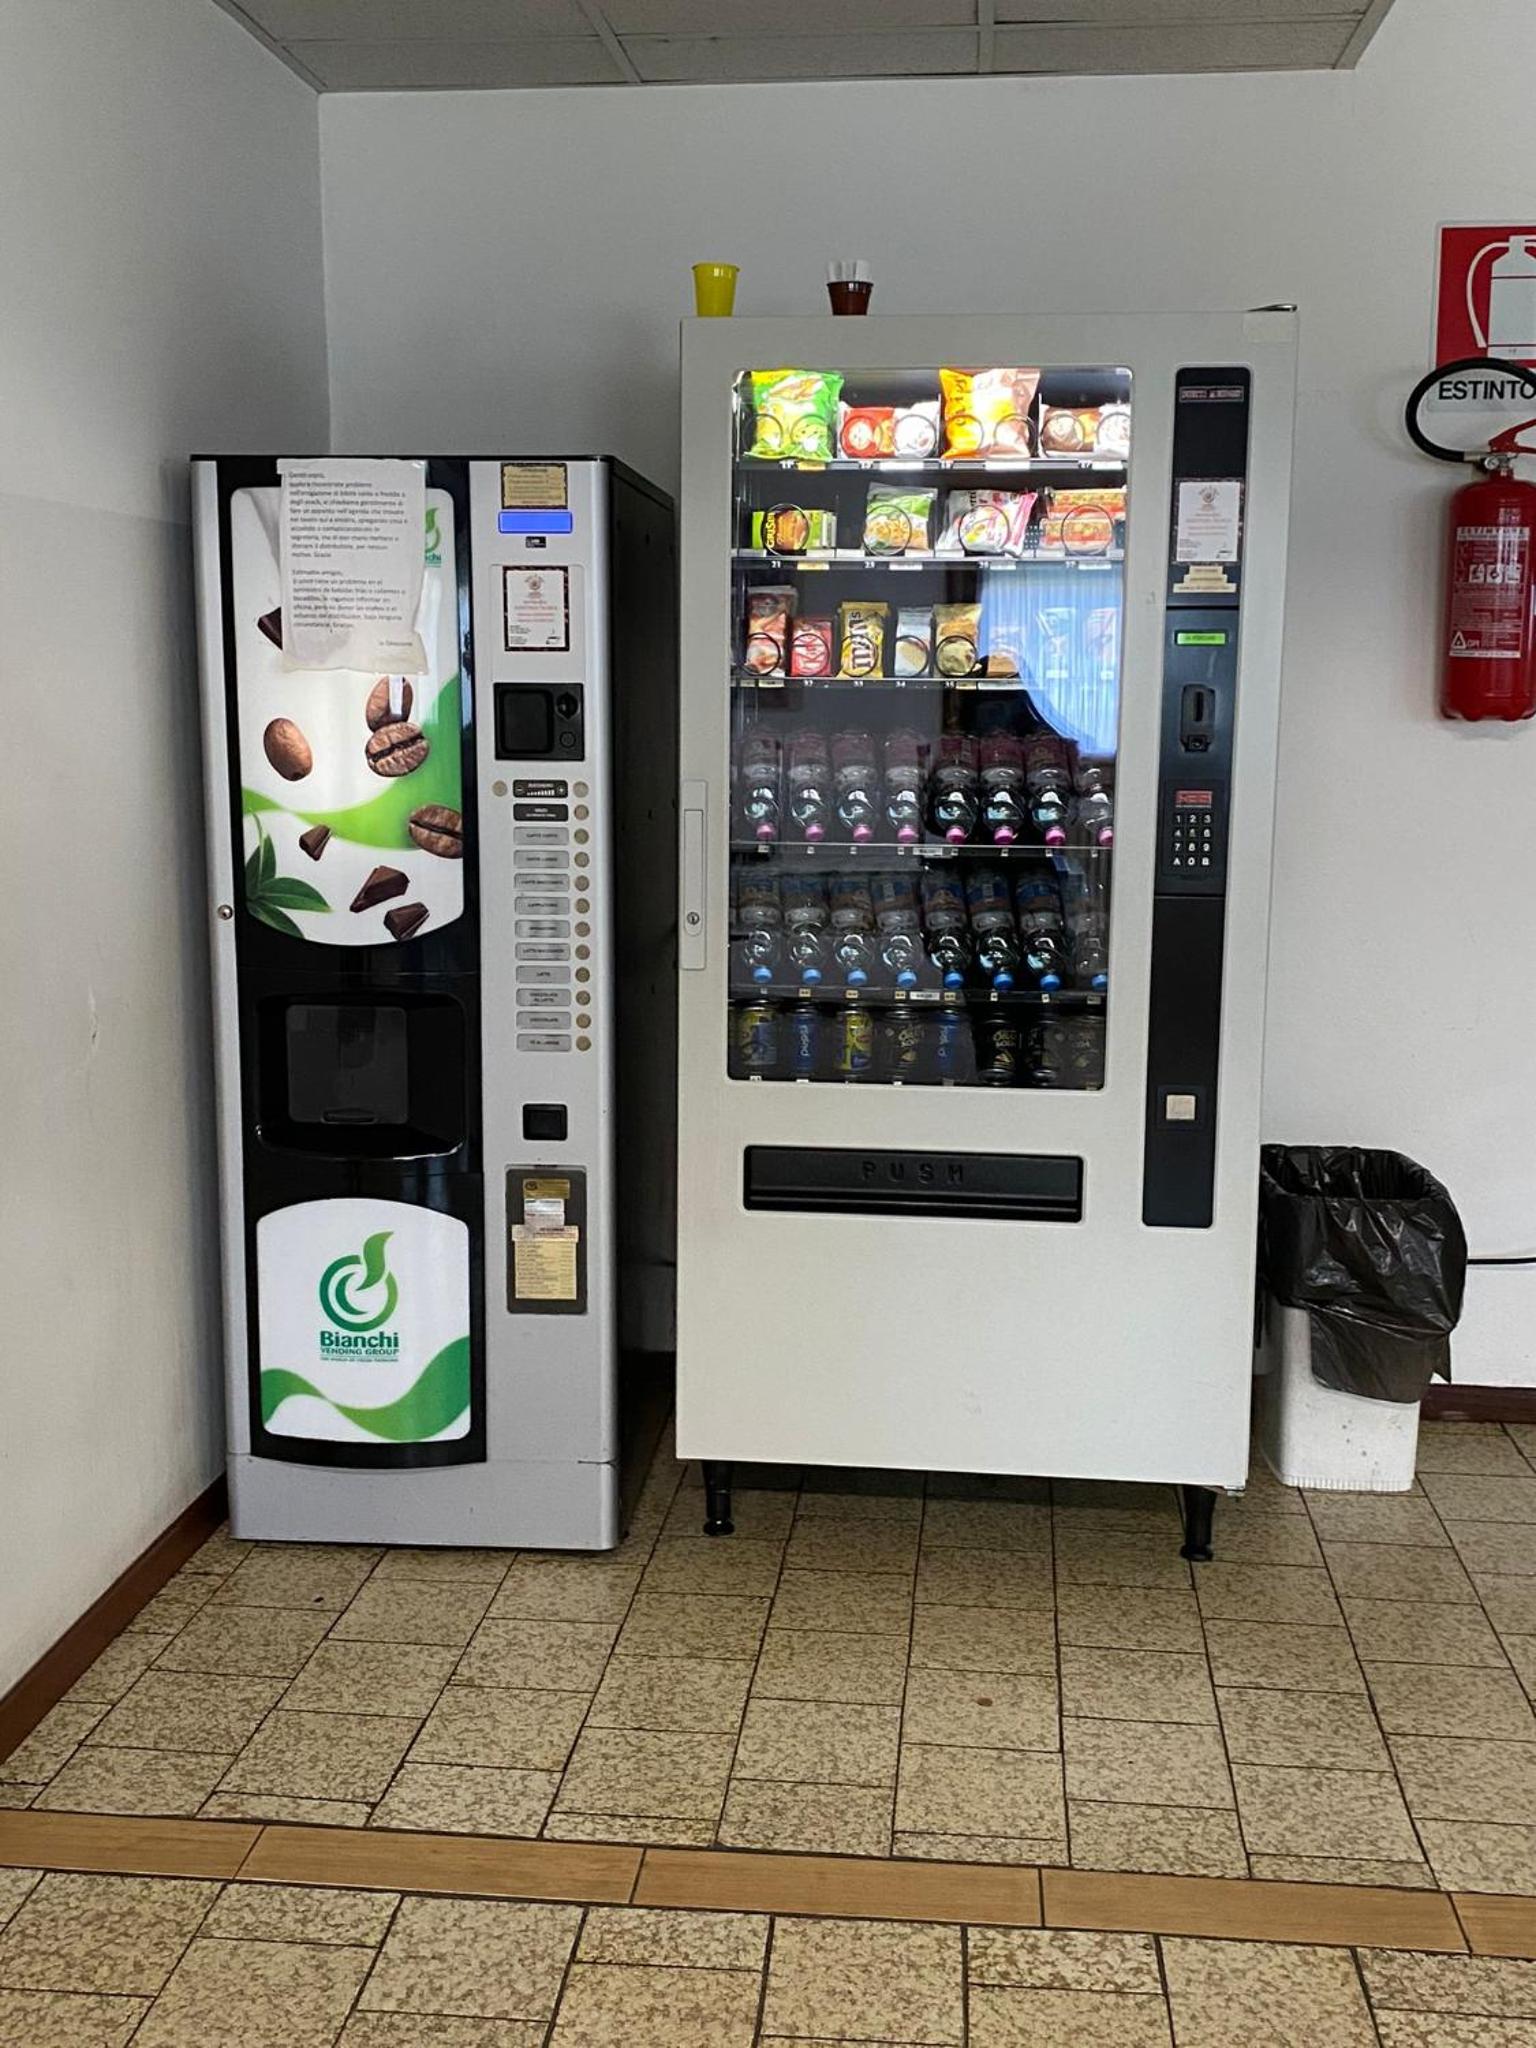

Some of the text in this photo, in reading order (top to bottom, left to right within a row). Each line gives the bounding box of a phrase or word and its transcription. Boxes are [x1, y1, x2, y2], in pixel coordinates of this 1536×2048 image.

[1176, 814, 1211, 823] 1 2 3
[1174, 829, 1181, 837] 4
[1174, 842, 1210, 852] 7 8 9
[1173, 857, 1181, 865] A
[861, 1159, 963, 1184] PUSH
[320, 1330, 399, 1348] Bianchi
